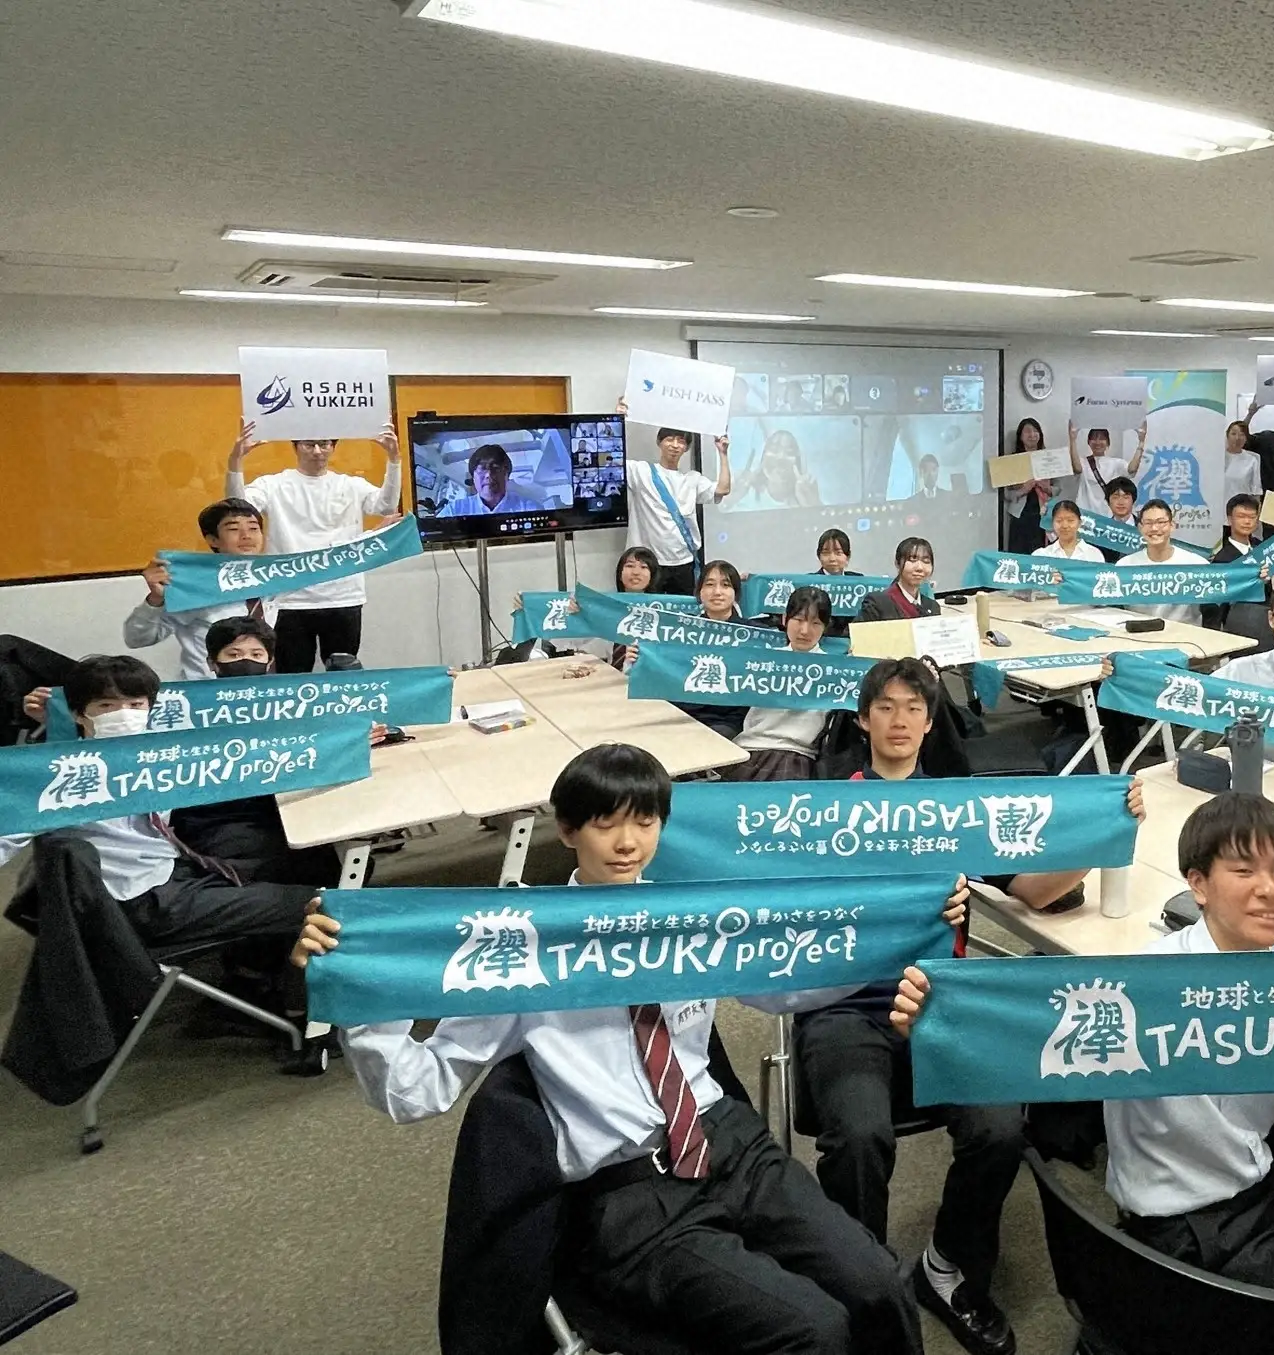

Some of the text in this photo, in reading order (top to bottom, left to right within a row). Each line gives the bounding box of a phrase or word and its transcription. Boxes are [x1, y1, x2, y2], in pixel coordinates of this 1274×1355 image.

[302, 382, 373, 394] ASAHI
[304, 396, 374, 407] YUKIZAI
[661, 385, 726, 407] FISH PASS
[1020, 572, 1057, 586] TASU
[1122, 571, 1228, 598] TASUKI project
[216, 687, 294, 702] 地球と生きる
[729, 663, 861, 704] TASUKI proje
[195, 683, 320, 729] TASUKI
[136, 733, 319, 765] 地球と生きる 豊かさをつなぐ
[112, 738, 317, 798] TASUKI project
[736, 793, 985, 858] TASUKI project
[582, 904, 865, 935] 地球と生きる 豊かさをつなぐ
[546, 906, 858, 982] TASUKI project
